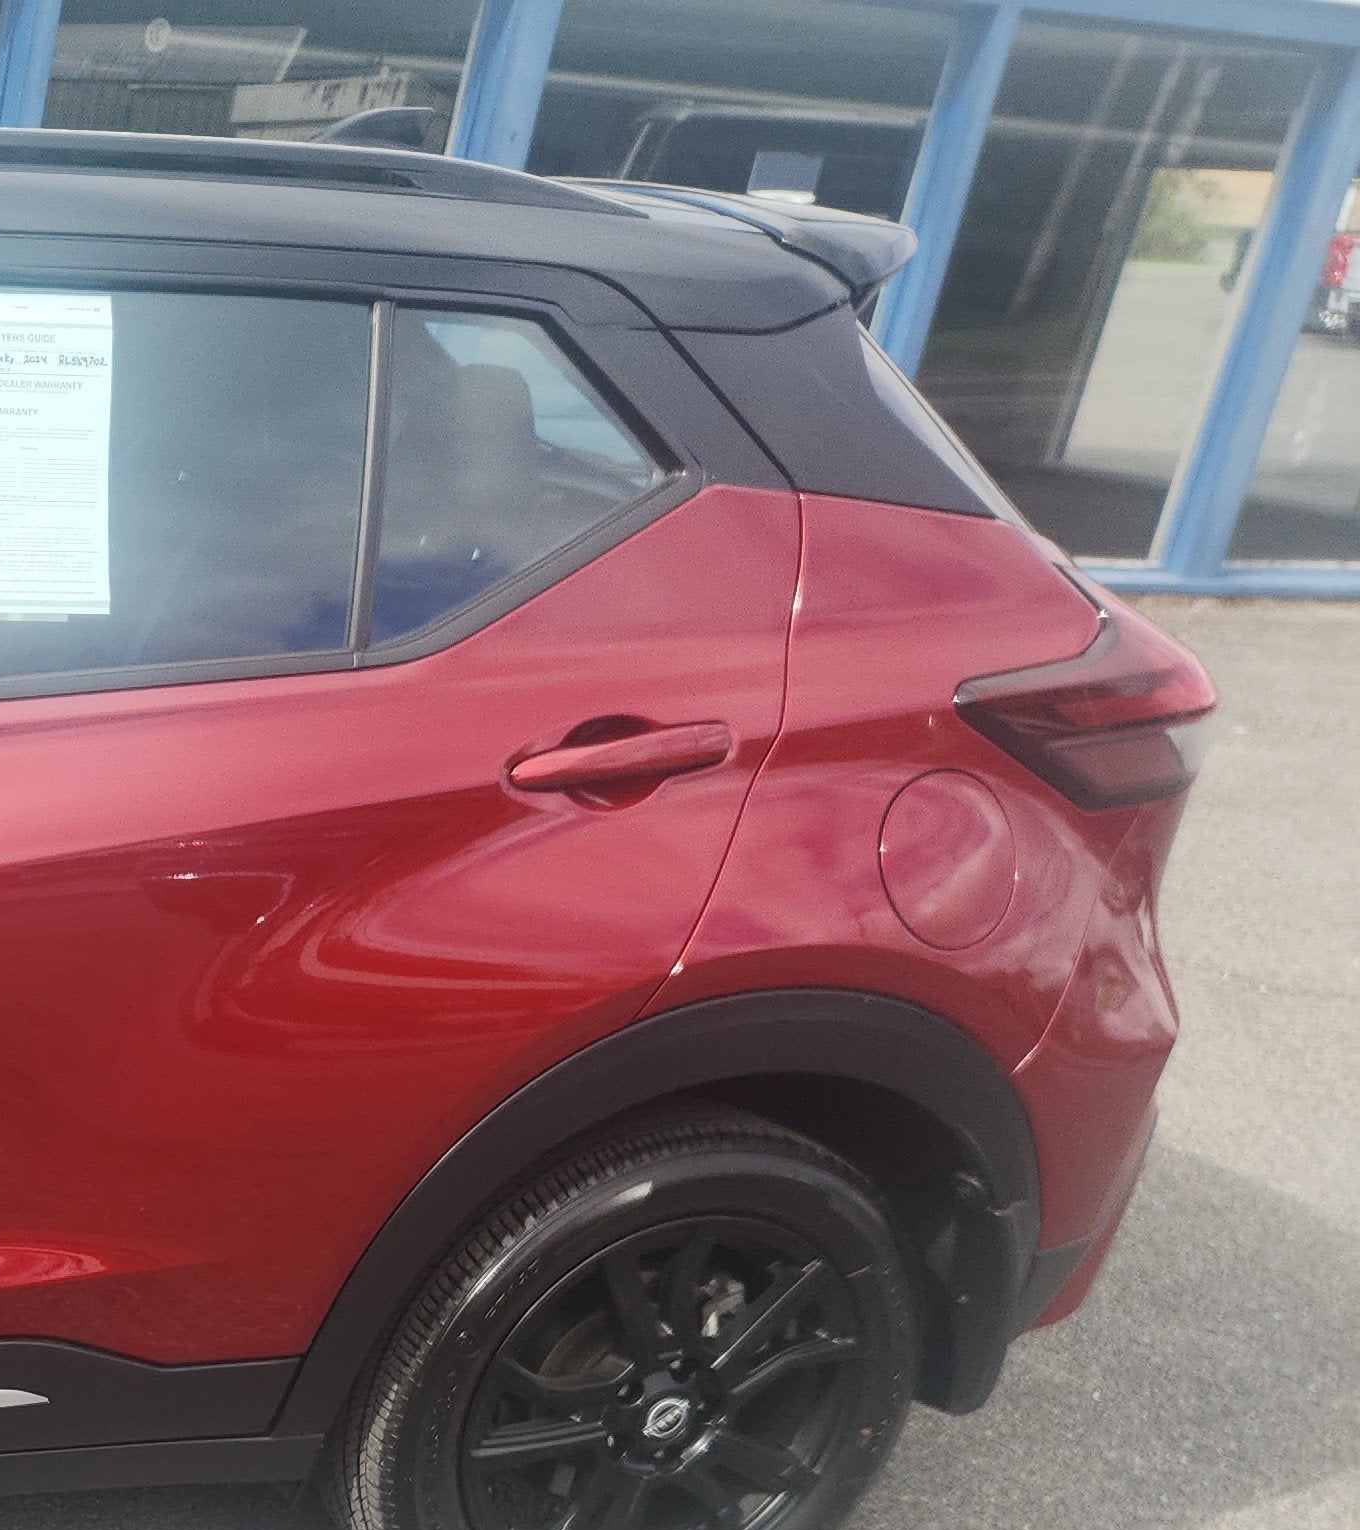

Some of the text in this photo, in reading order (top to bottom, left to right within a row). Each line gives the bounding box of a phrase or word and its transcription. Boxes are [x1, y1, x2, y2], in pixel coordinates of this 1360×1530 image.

[27, 333, 57, 343] GUIDE
[23, 354, 48, 365] 2024
[34, 381, 83, 390] WARRANTY
